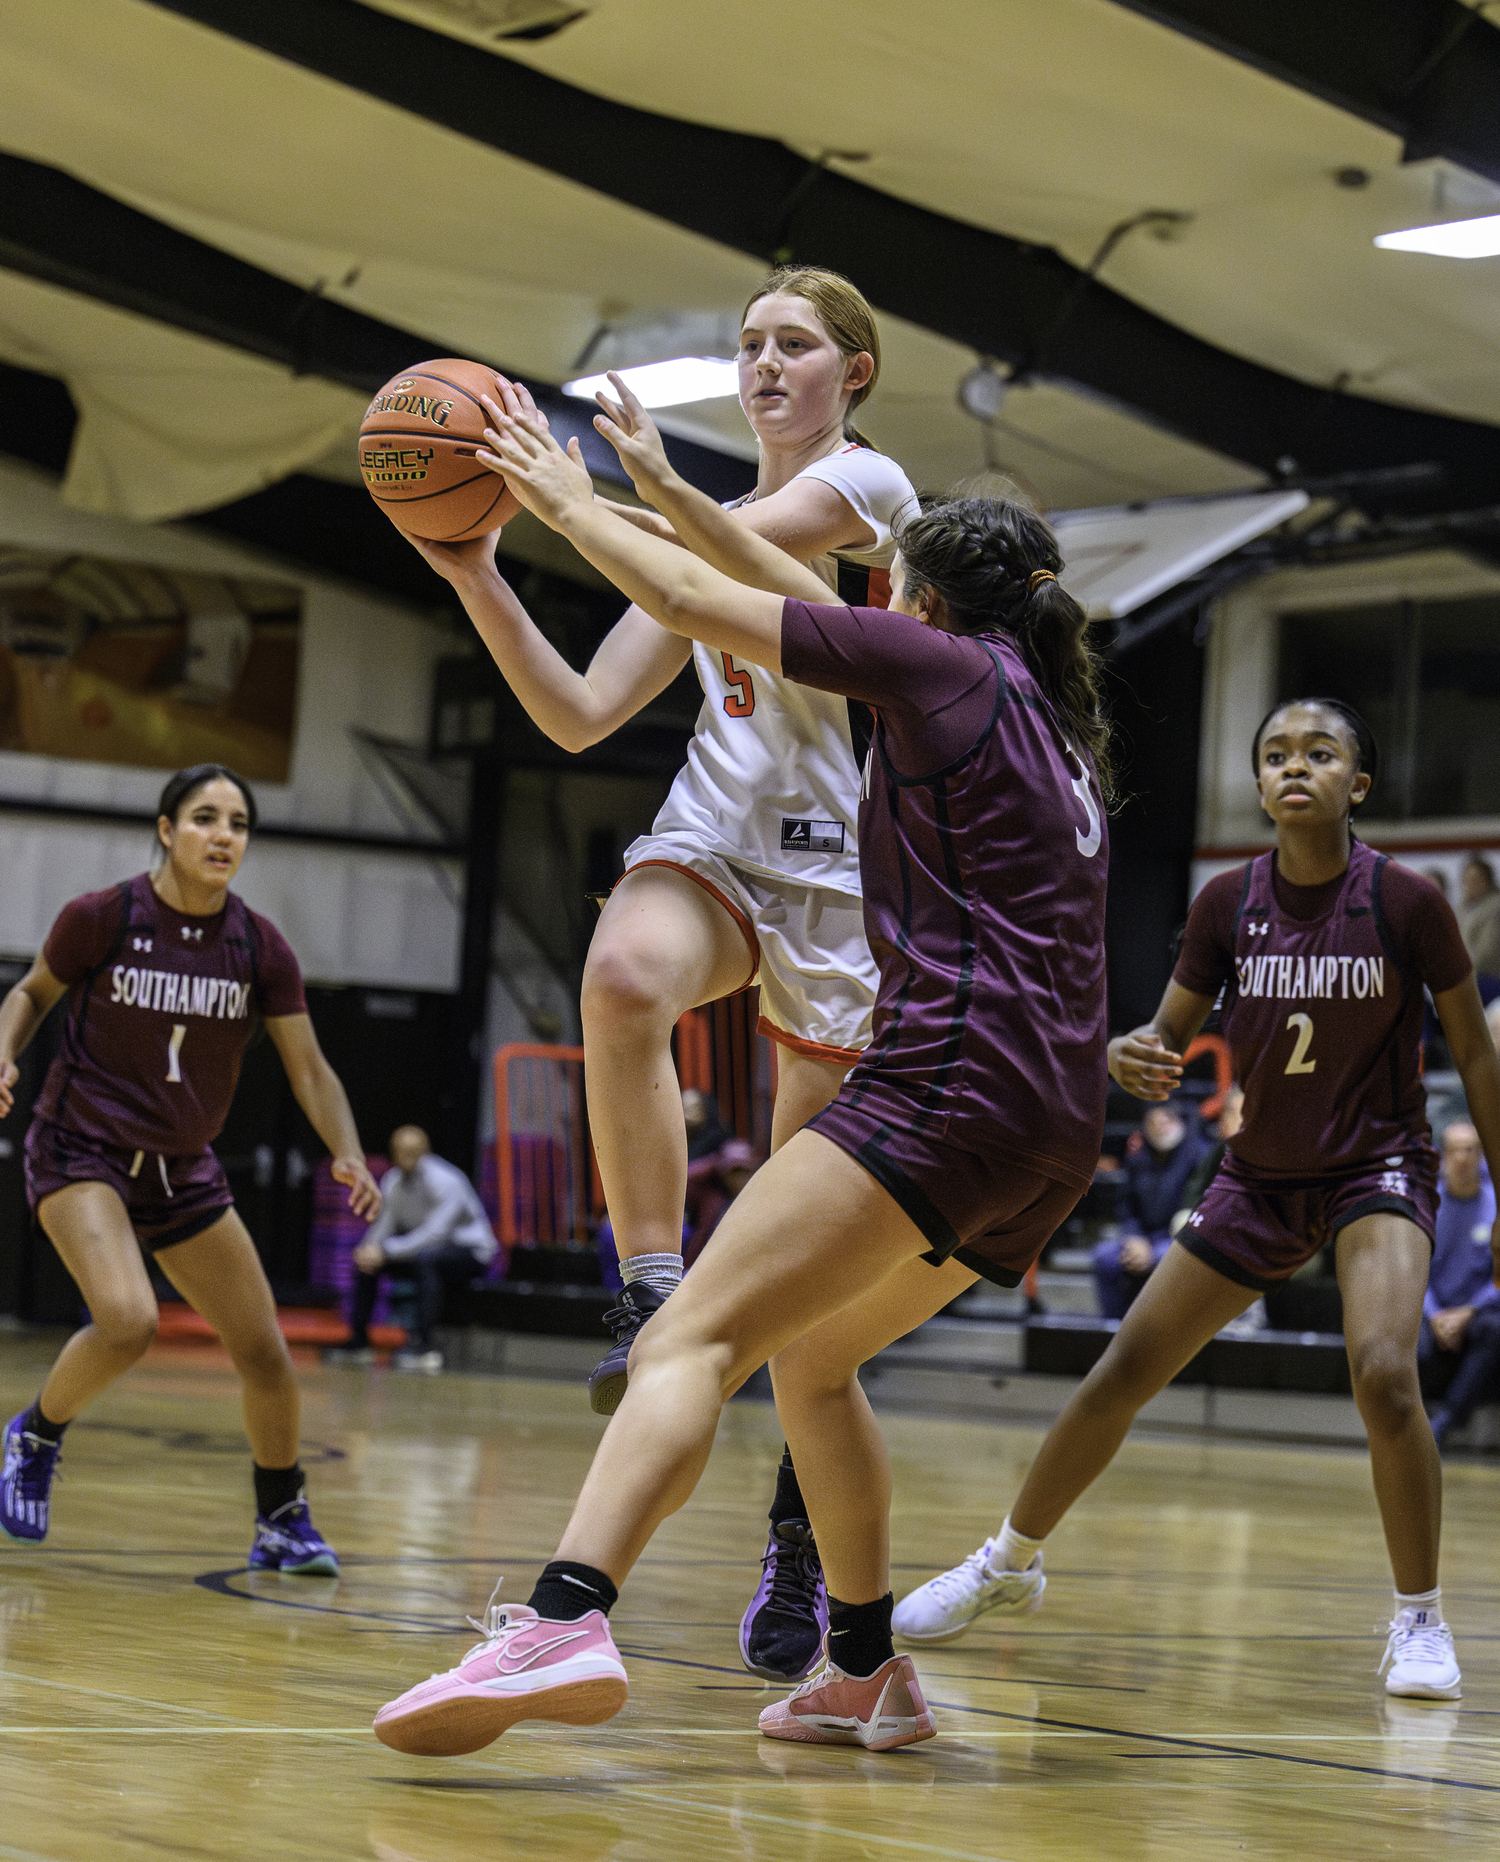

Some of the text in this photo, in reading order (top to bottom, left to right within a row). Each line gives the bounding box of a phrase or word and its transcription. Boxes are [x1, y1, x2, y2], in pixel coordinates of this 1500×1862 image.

[721, 651, 756, 718] 5
[822, 838, 830, 848] S
[165, 1024, 188, 1083] 1
[1284, 1012, 1317, 1075] 2
